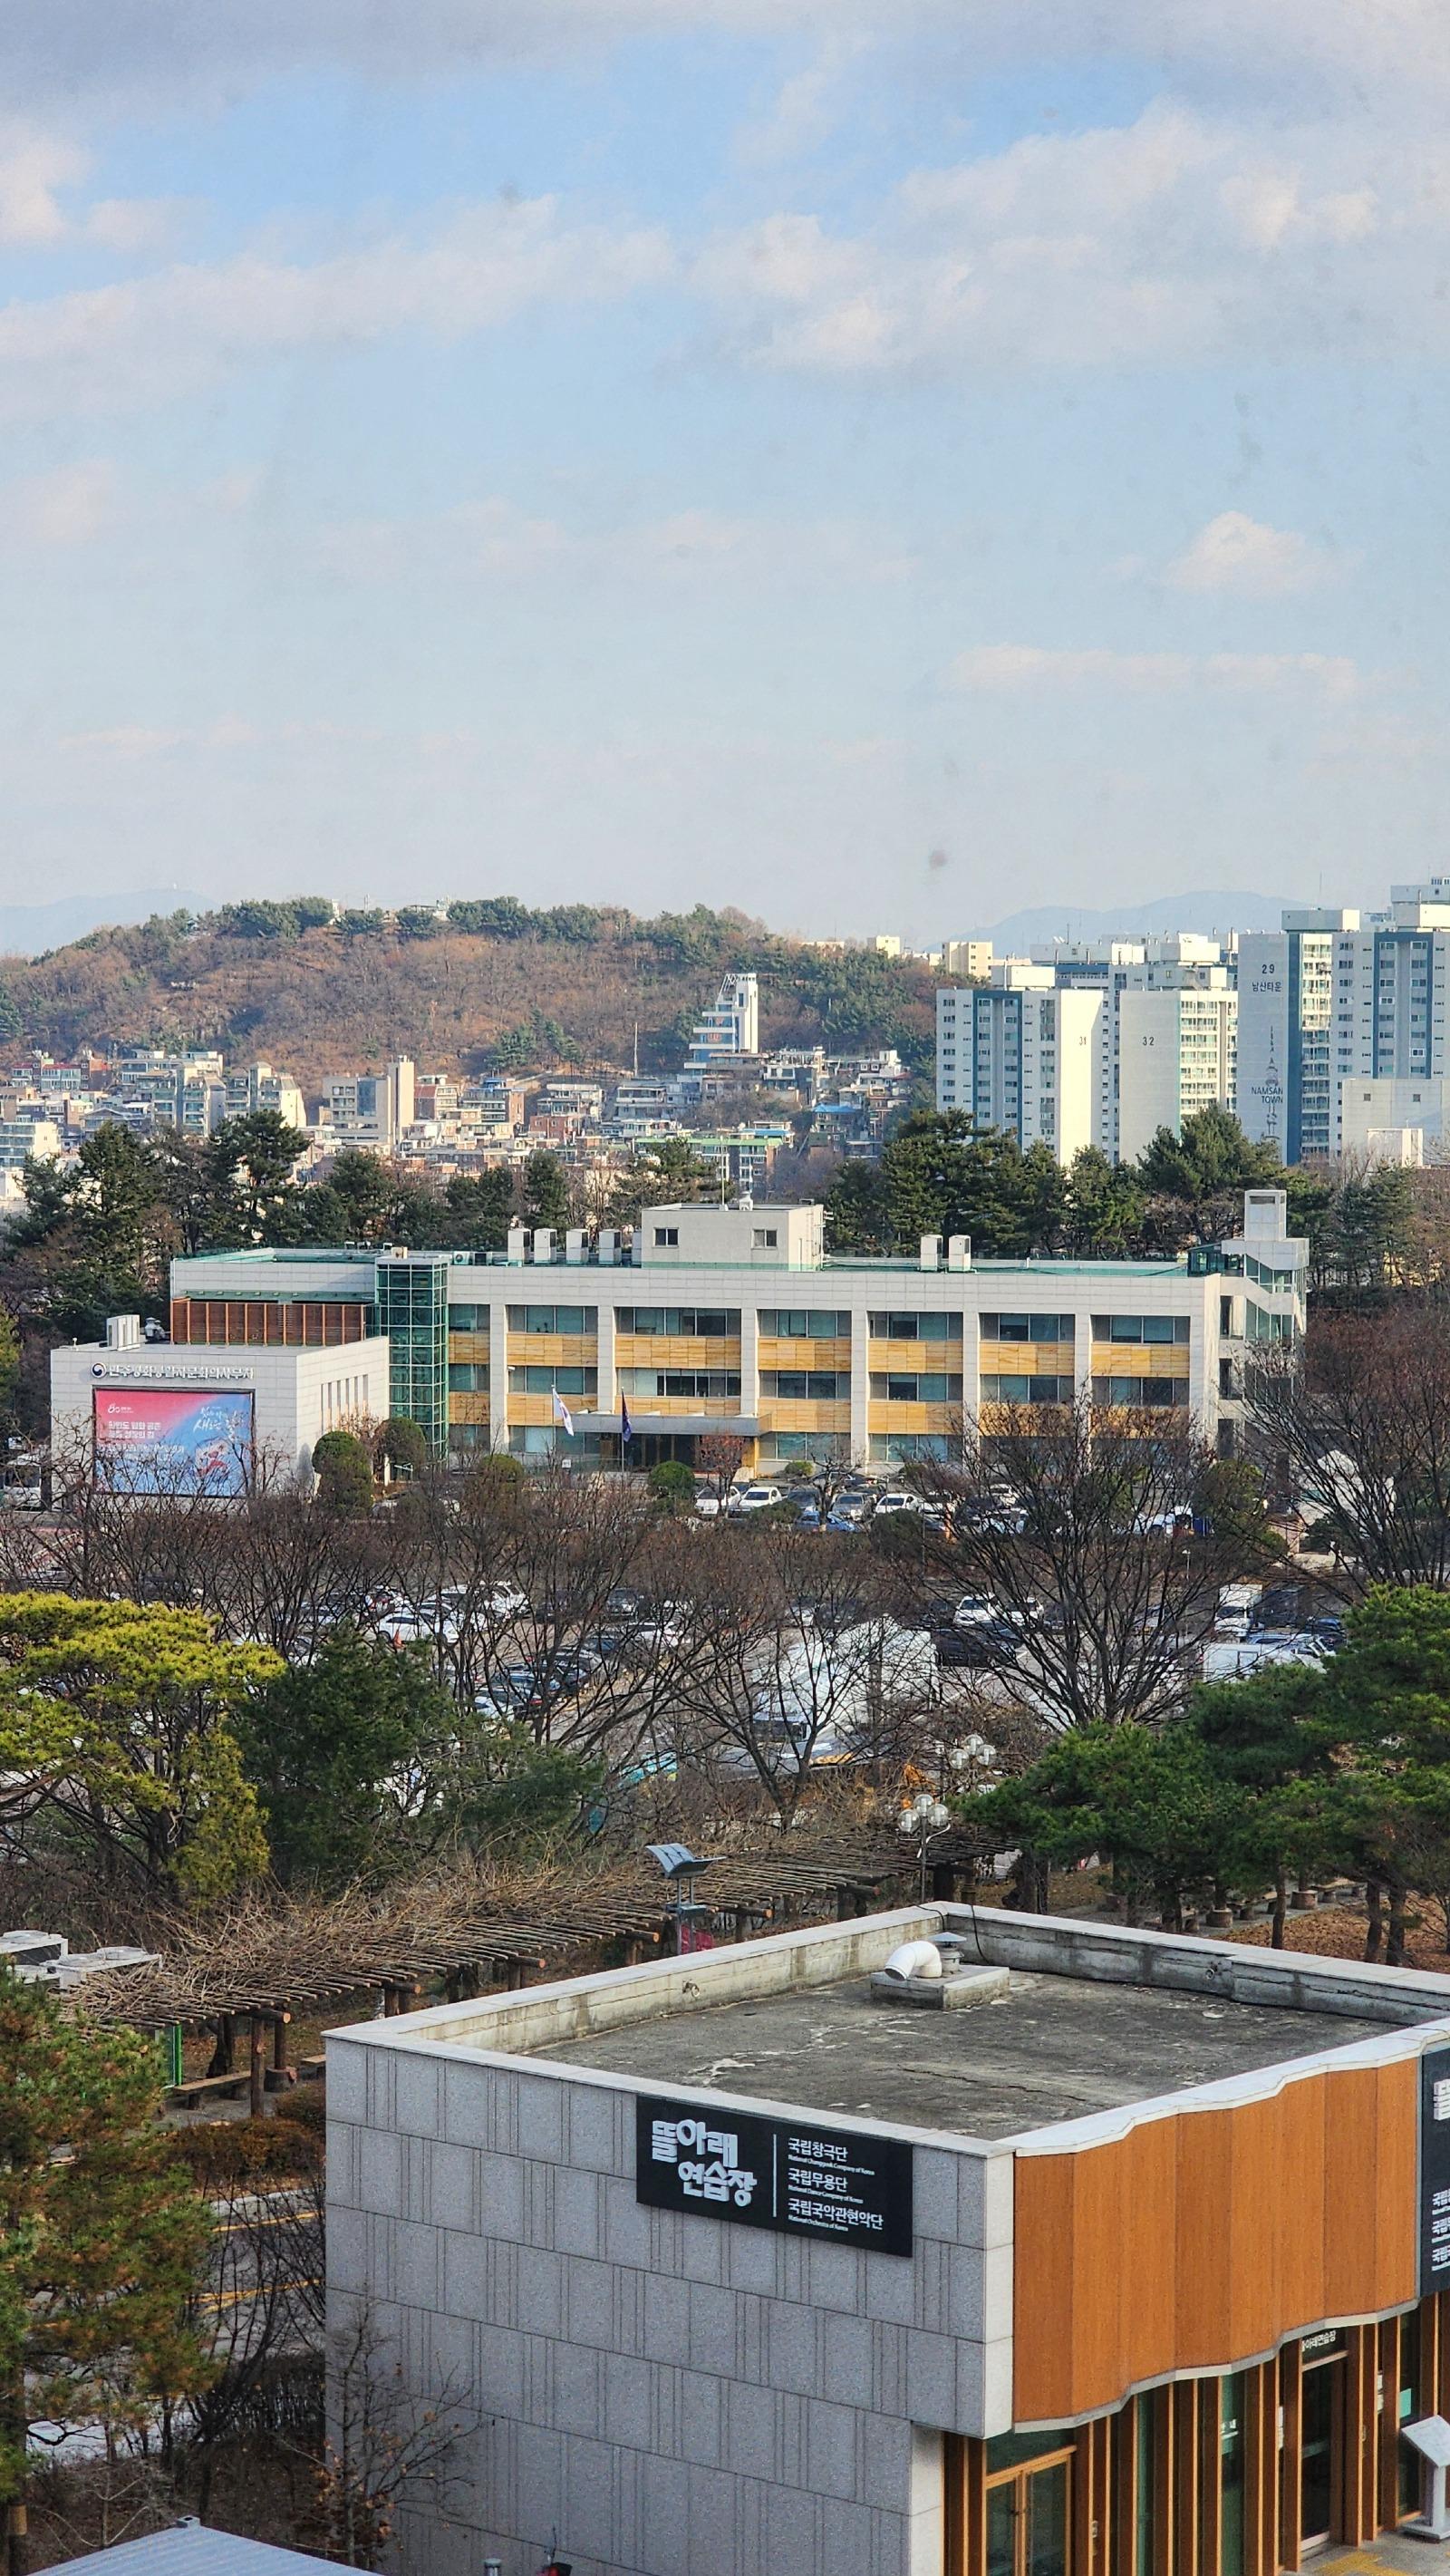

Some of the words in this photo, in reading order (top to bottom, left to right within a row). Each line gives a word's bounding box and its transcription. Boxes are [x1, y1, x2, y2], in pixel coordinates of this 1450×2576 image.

[1262, 964, 1275, 974] 29
[1252, 982, 1282, 993] 남산타운
[1142, 1036, 1155, 1046] 32
[1251, 1087, 1283, 1096] NAMSAN
[1261, 1095, 1283, 1104] TOWN
[652, 2119, 739, 2169] 뜰아래
[788, 2137, 849, 2163] 국립창극단
[678, 2160, 758, 2208] 연습장
[788, 2168, 849, 2193] 국립무용단
[788, 2197, 884, 2231] 국립국악관현악단
